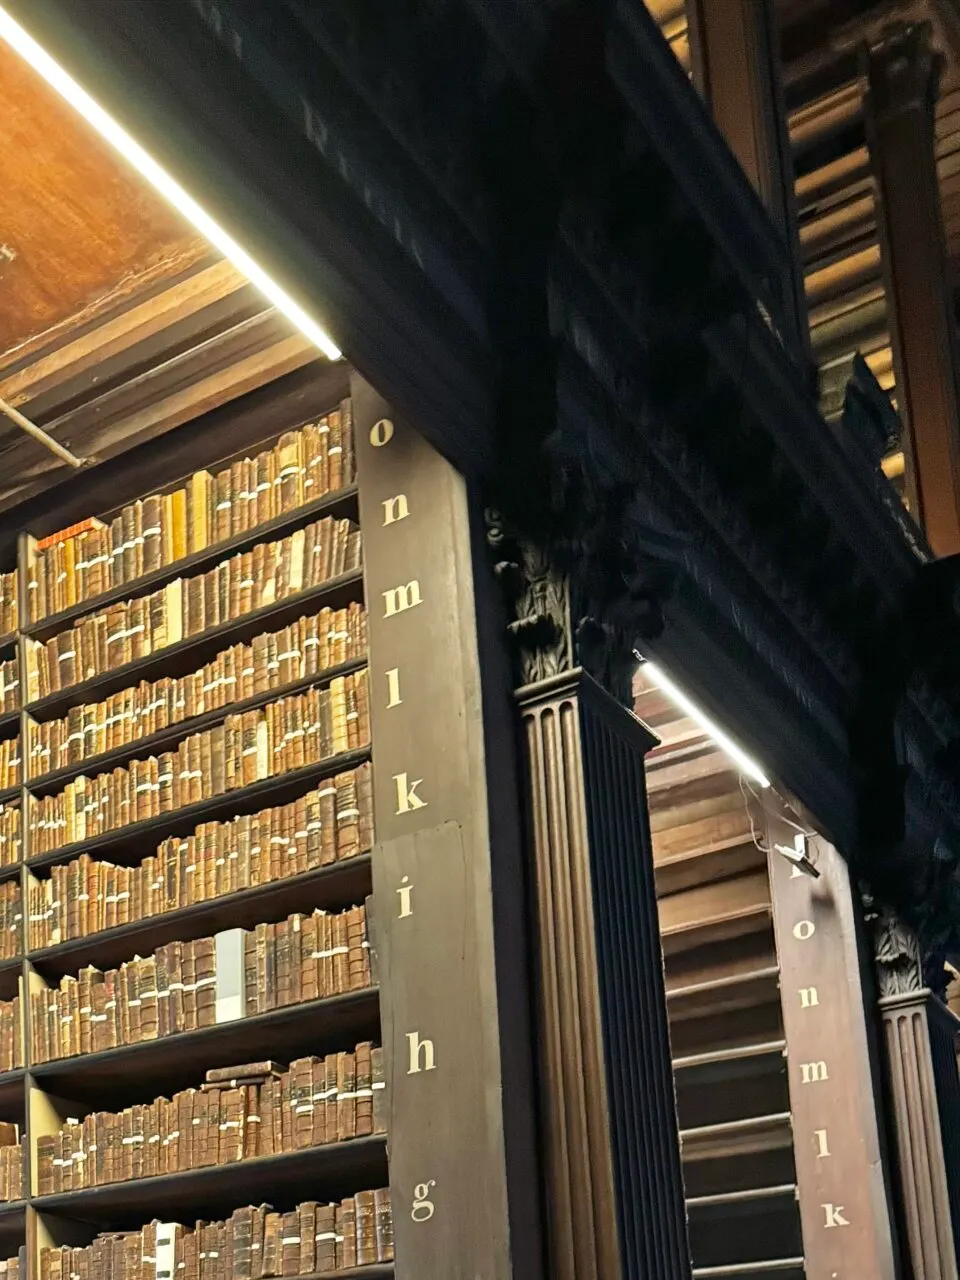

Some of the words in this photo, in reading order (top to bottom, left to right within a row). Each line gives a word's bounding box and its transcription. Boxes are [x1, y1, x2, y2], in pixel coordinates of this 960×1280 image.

[370, 419, 393, 446] o
[382, 495, 410, 526] n
[382, 581, 423, 617] m
[393, 773, 427, 814] k
[397, 876, 413, 918] i
[793, 920, 814, 939] o
[799, 988, 818, 1008] n
[406, 1032, 436, 1074] h
[800, 1061, 828, 1083] m
[412, 1180, 435, 1221] g
[821, 1204, 849, 1227] k
